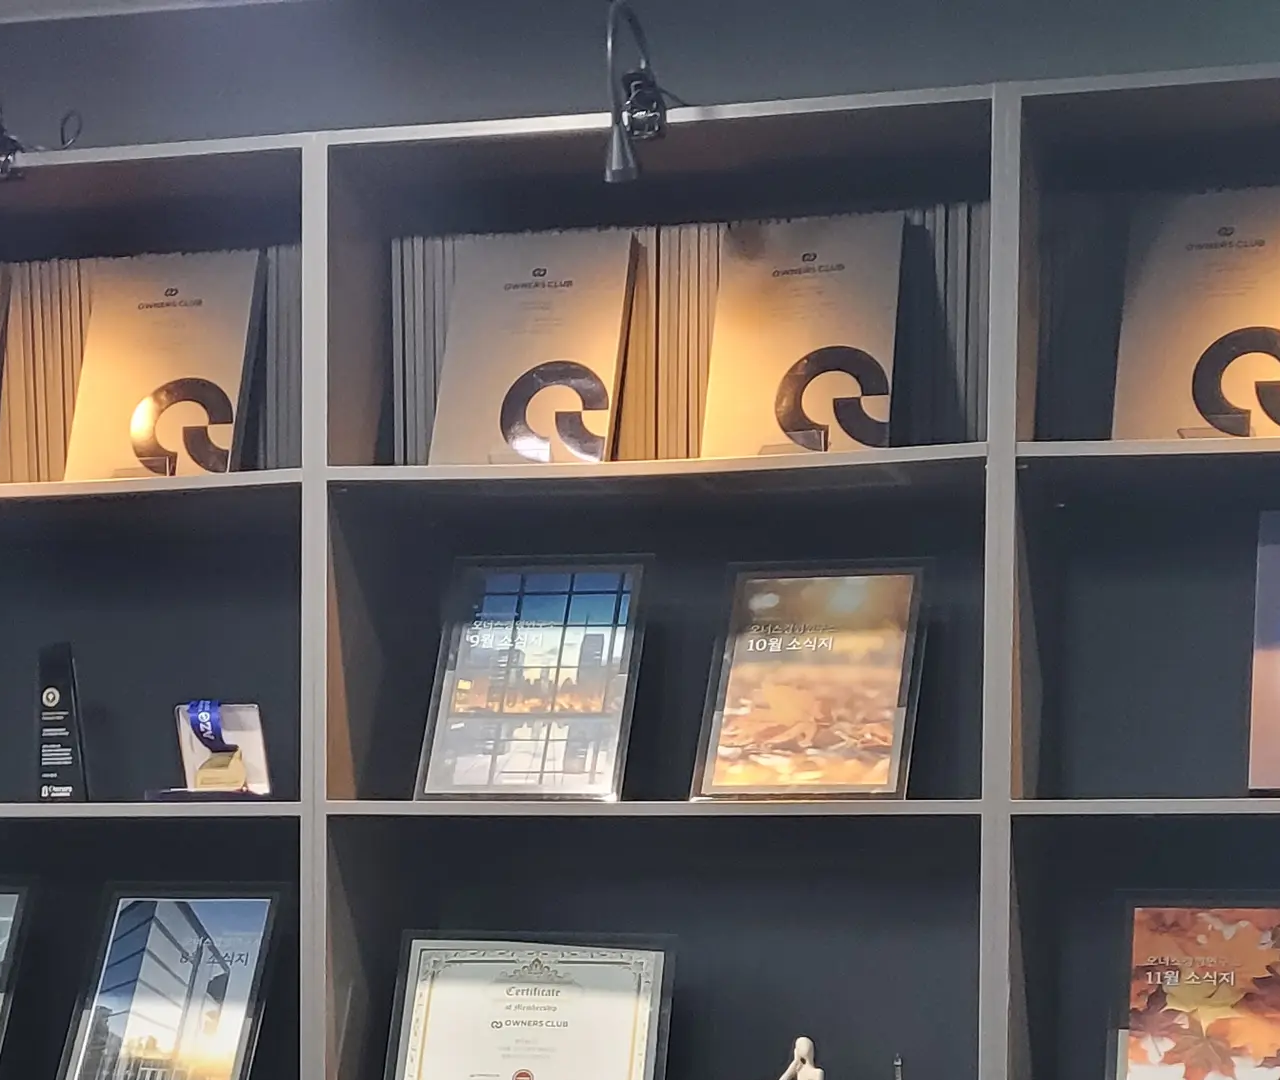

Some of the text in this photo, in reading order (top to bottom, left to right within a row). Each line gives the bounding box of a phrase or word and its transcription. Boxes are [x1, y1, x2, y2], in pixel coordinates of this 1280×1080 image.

[746, 635, 834, 653] 10월 소식지
[1145, 969, 1235, 986] 11월 소식지
[505, 986, 561, 997] Certificate
[504, 1019, 569, 1028] OWNERS CLUB
